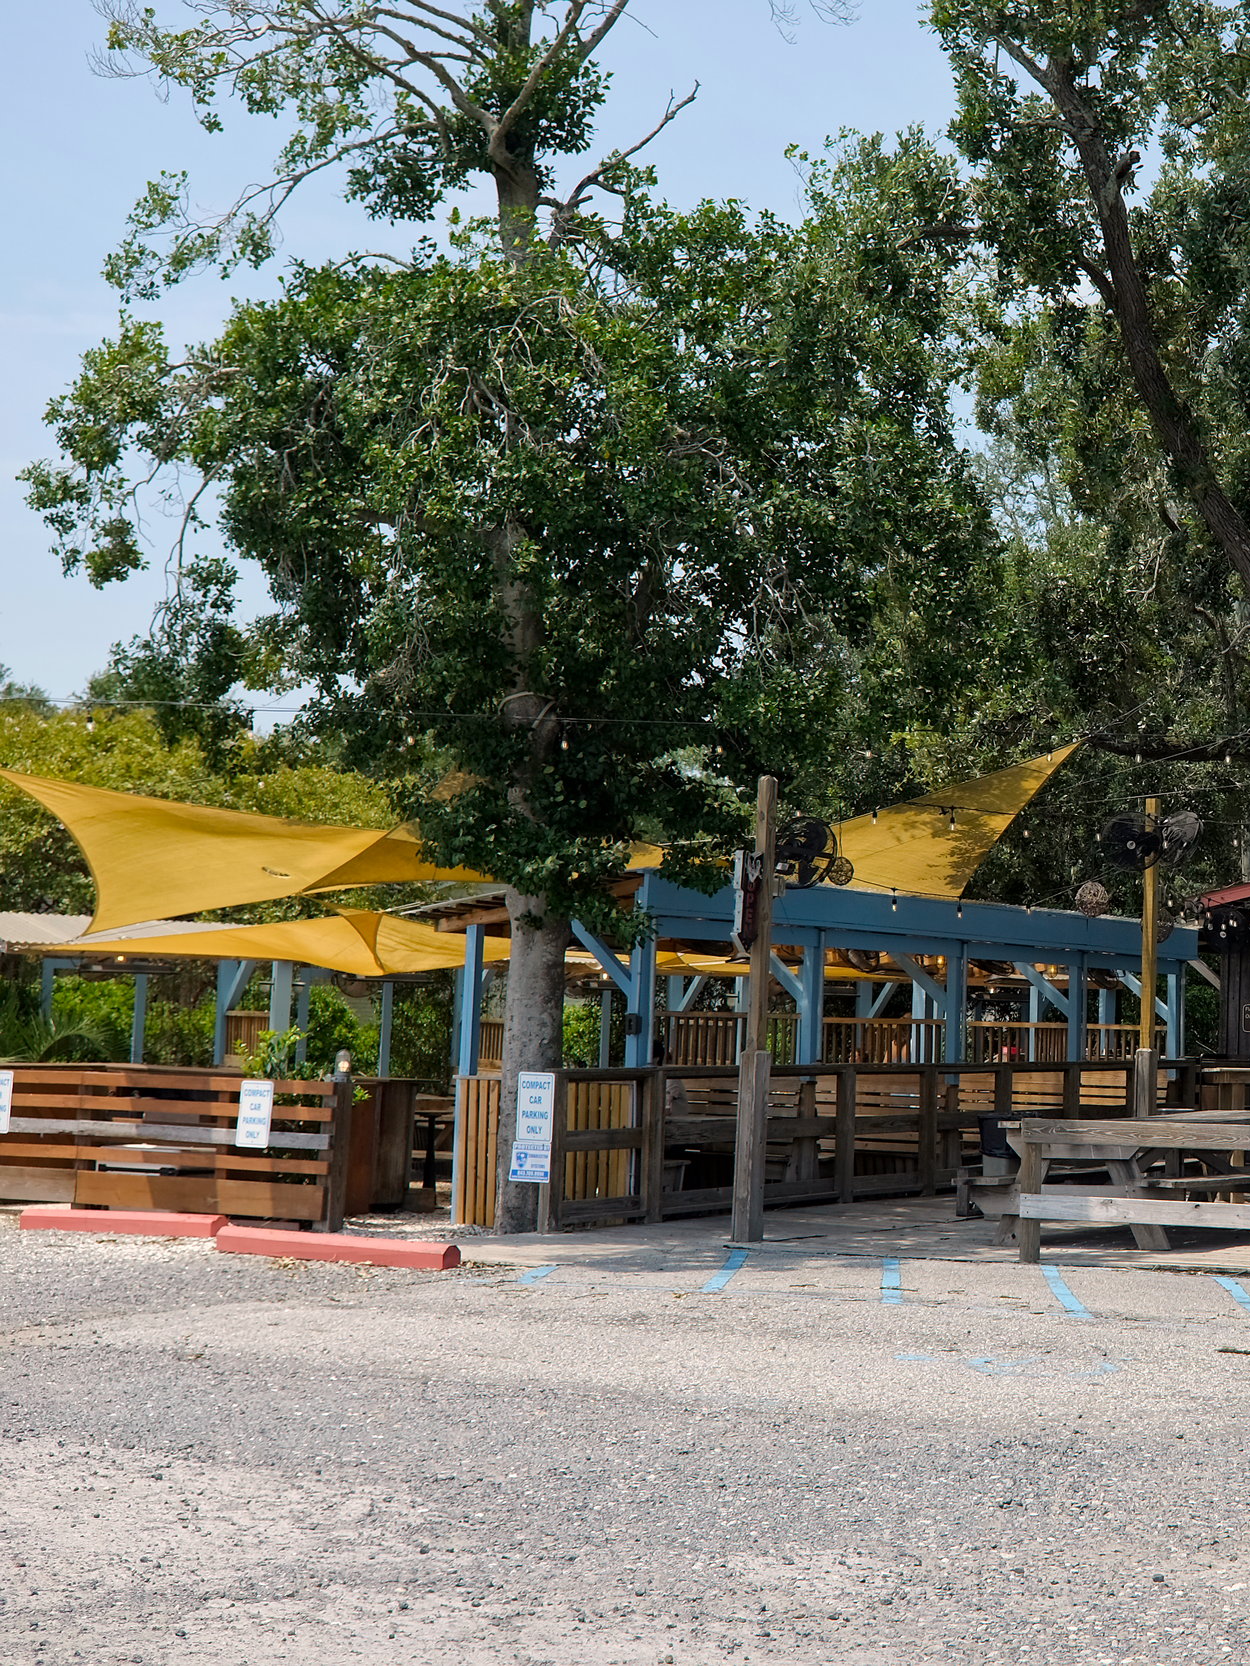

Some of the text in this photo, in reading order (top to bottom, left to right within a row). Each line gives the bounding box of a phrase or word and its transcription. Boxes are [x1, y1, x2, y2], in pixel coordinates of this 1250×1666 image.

[522, 1080, 551, 1090] COMPACT
[244, 1088, 271, 1097] COMPACT
[529, 1096, 542, 1104] CAR
[249, 1103, 261, 1111] CAR
[522, 1111, 548, 1120] PARKING
[242, 1116, 266, 1125] PARKING
[526, 1125, 542, 1134] ONLY
[245, 1131, 260, 1139] ONLY
